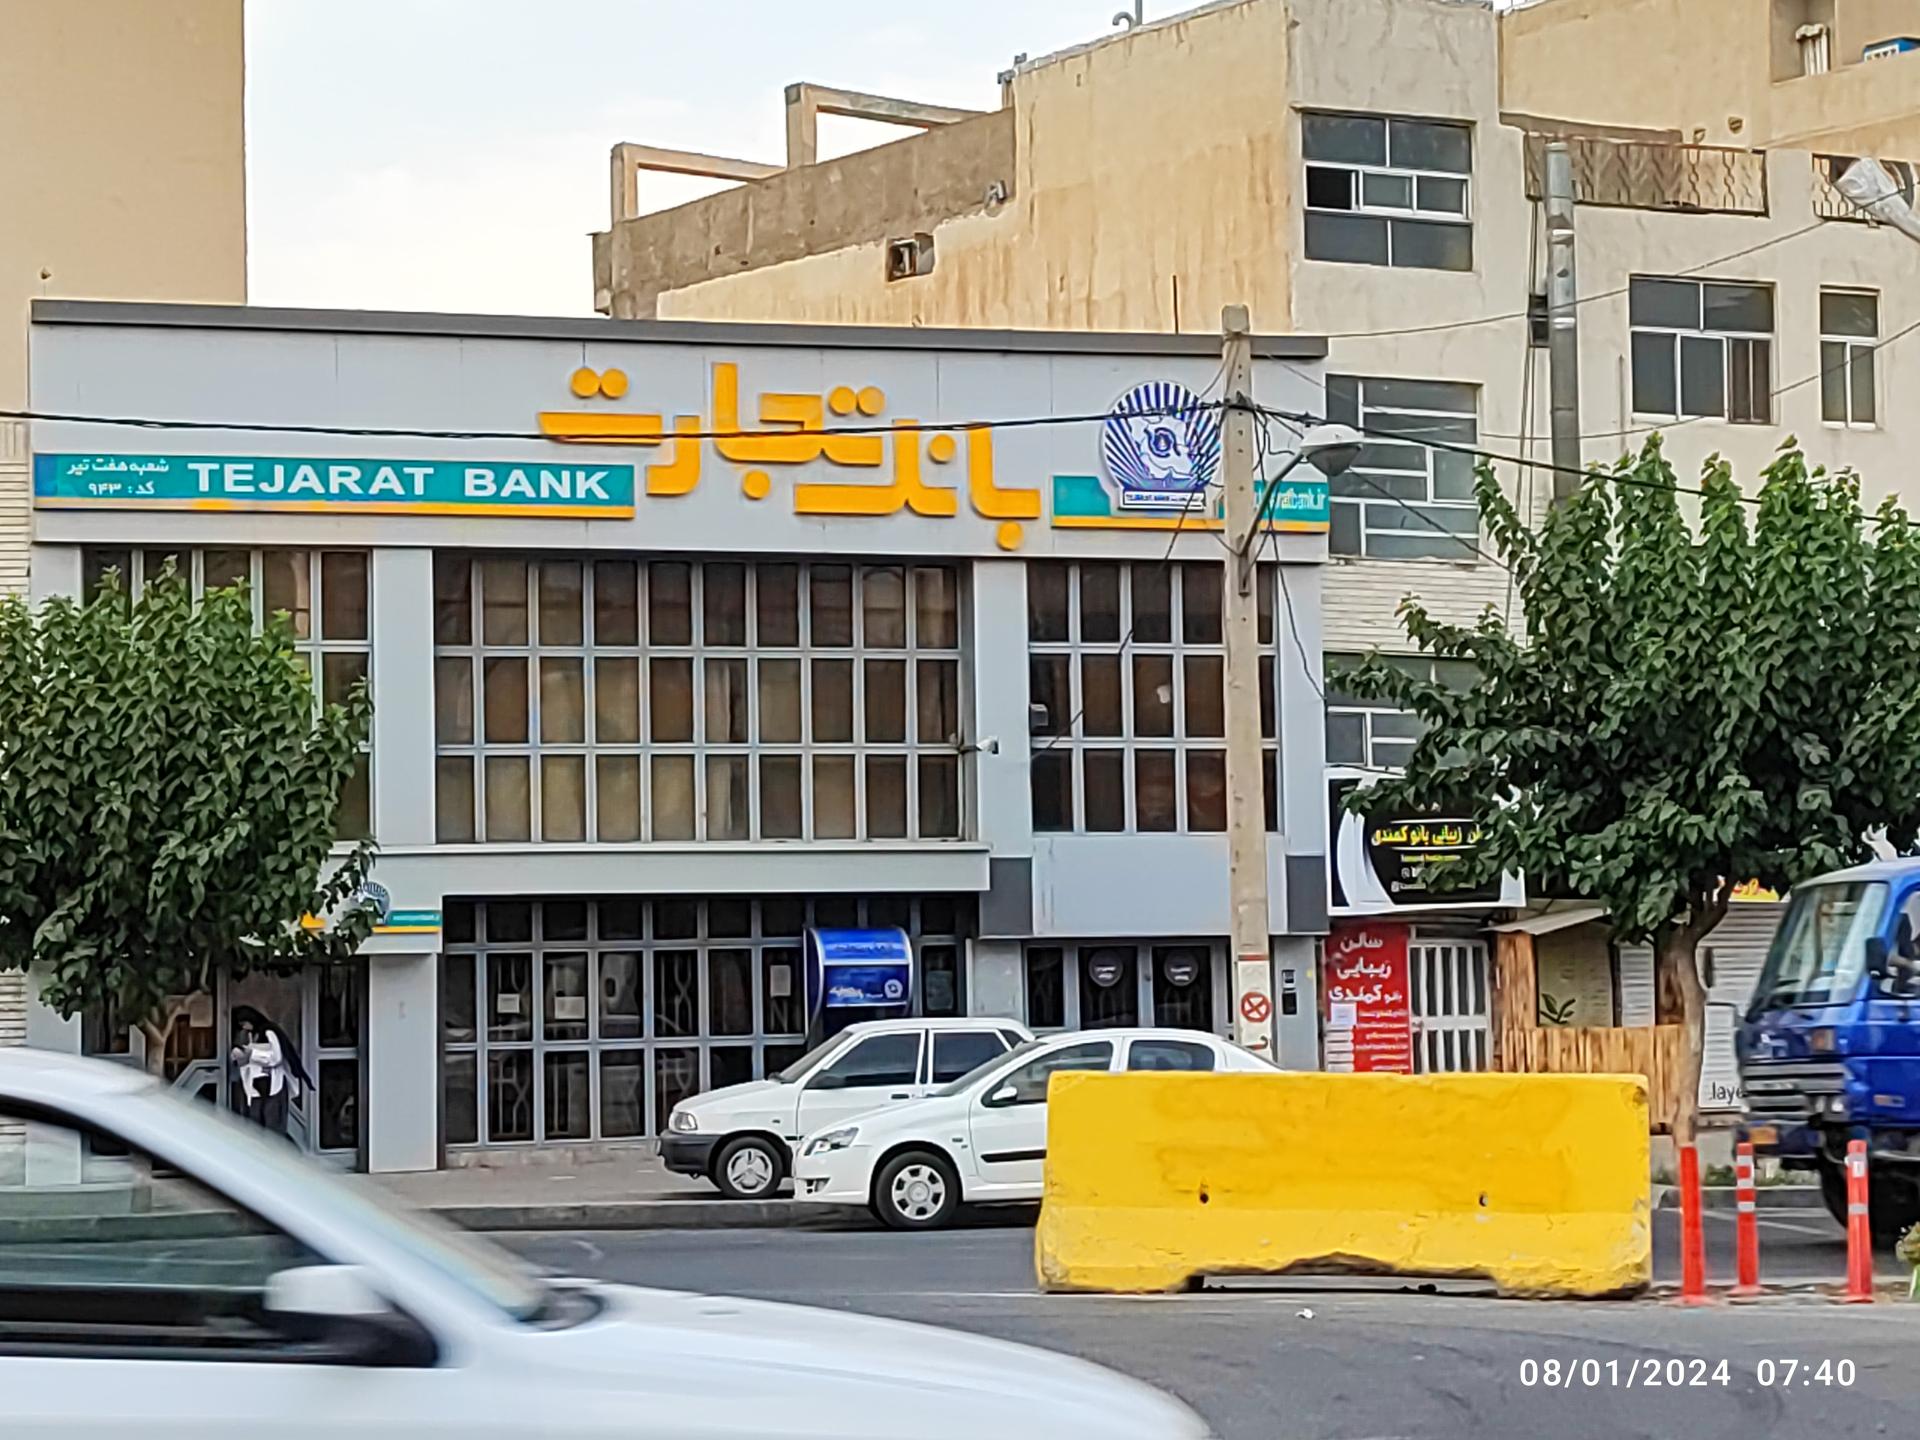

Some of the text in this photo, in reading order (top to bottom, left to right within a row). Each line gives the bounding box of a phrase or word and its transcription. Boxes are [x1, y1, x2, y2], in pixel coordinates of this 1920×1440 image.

[66, 457, 170, 476] شعبه هفت تیر
[538, 361, 1041, 552] بانک تجارت
[187, 462, 611, 500] TEJARAT BANK
[1339, 931, 1384, 953] سالن
[1337, 958, 1392, 980] زیبایی
[1328, 984, 1383, 1005] کمندی
[1711, 1081, 1745, 1105] laye
